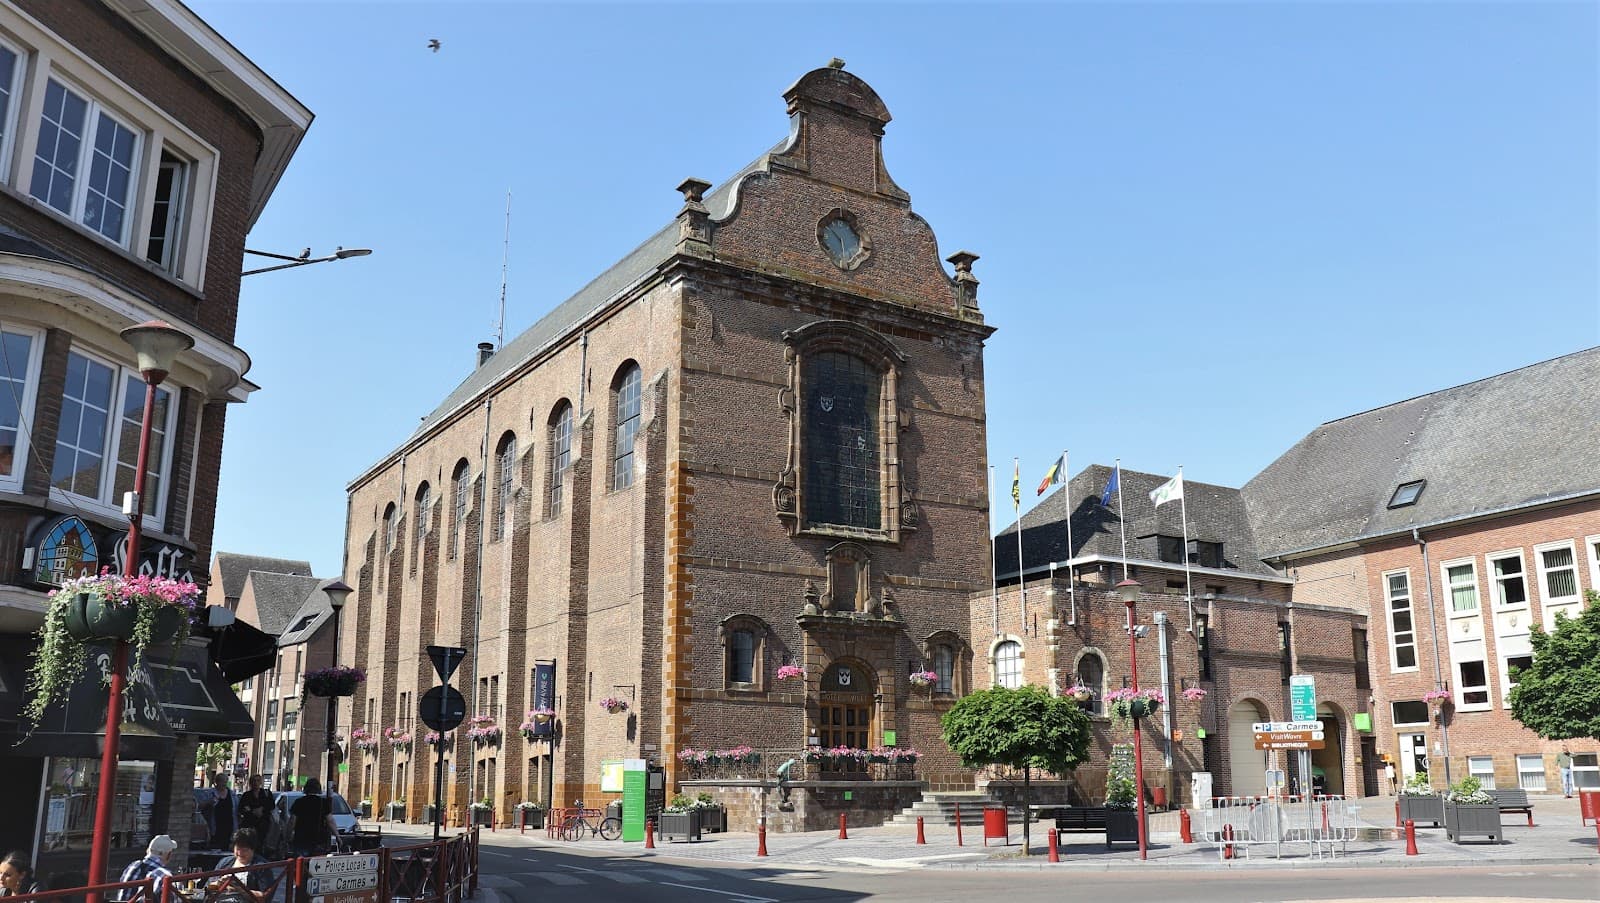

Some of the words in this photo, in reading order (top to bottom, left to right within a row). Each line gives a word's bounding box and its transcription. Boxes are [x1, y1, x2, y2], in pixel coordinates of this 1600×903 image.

[1287, 723, 1318, 731] Carmes
[325, 860, 345, 873] Police
[346, 858, 366, 871] Locale
[336, 878, 366, 890] Carmes
